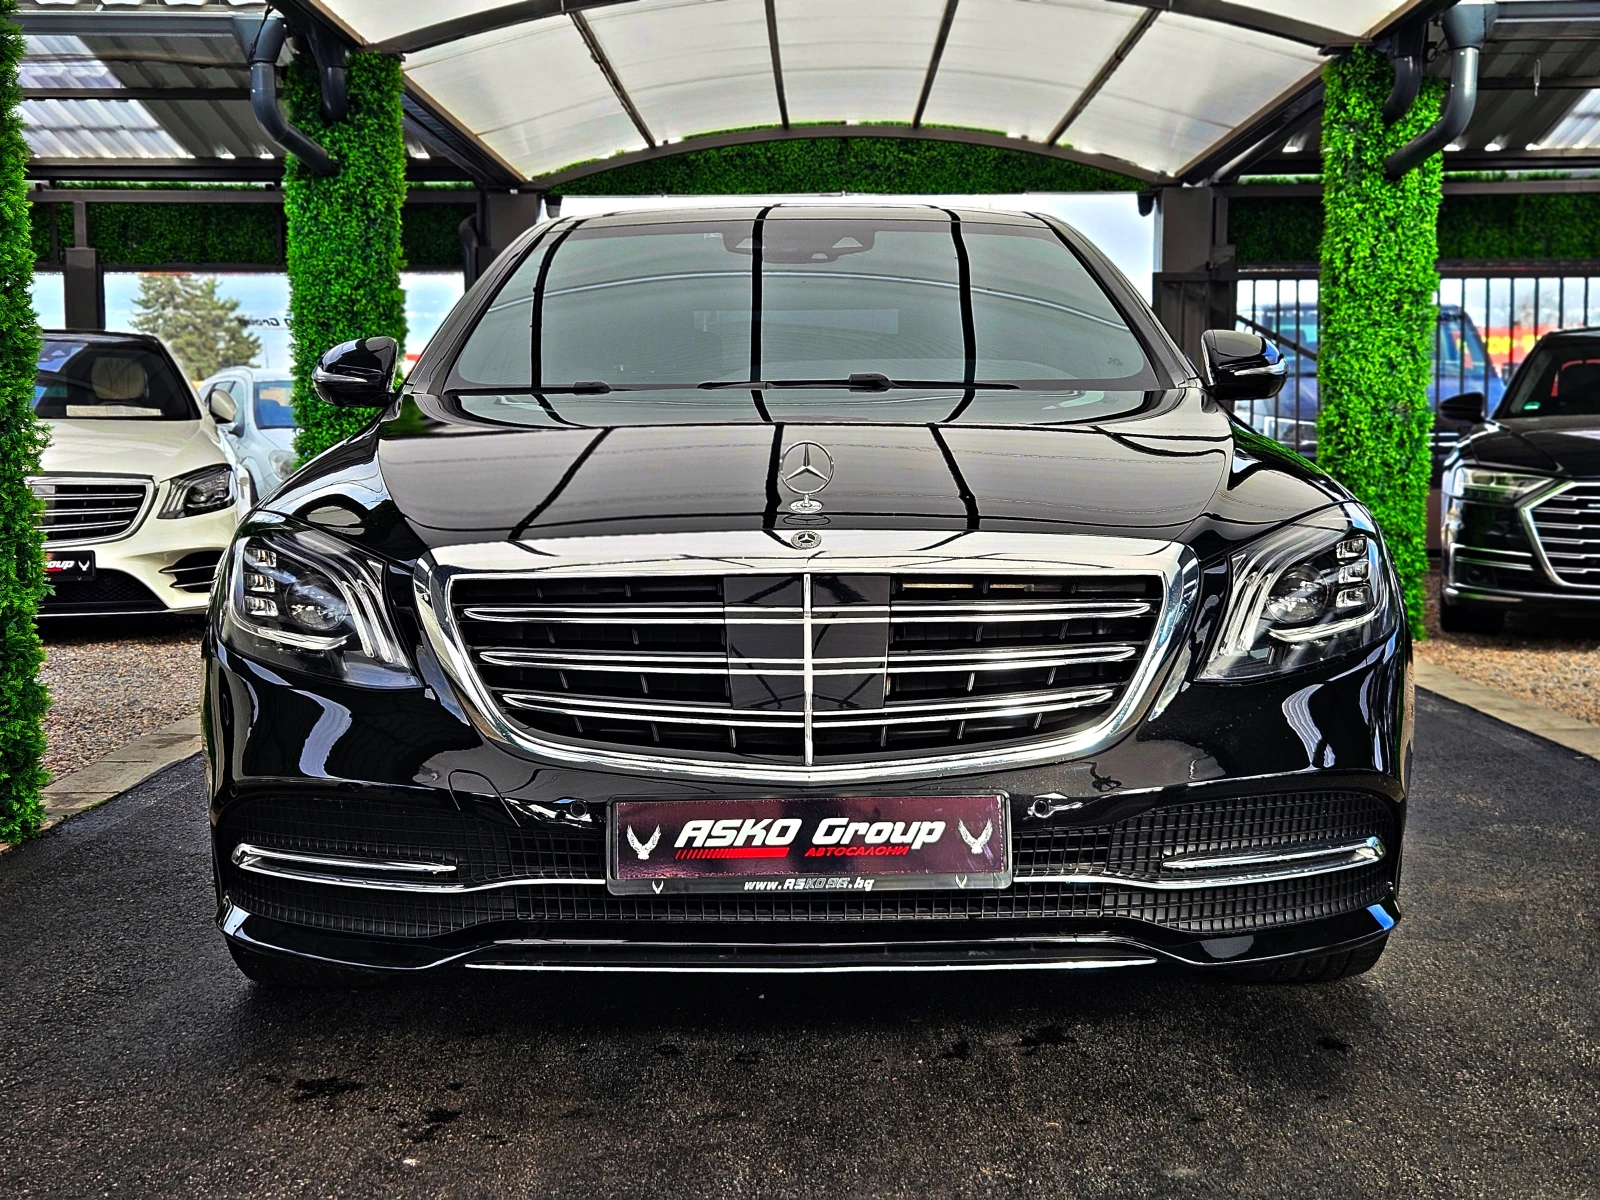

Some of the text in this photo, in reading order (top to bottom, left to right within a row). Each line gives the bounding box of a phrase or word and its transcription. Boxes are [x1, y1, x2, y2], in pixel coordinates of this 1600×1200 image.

[45, 560, 75, 570] oup
[673, 817, 947, 850] ASKO Group
[804, 845, 910, 858] АВТОСАЛОНИ
